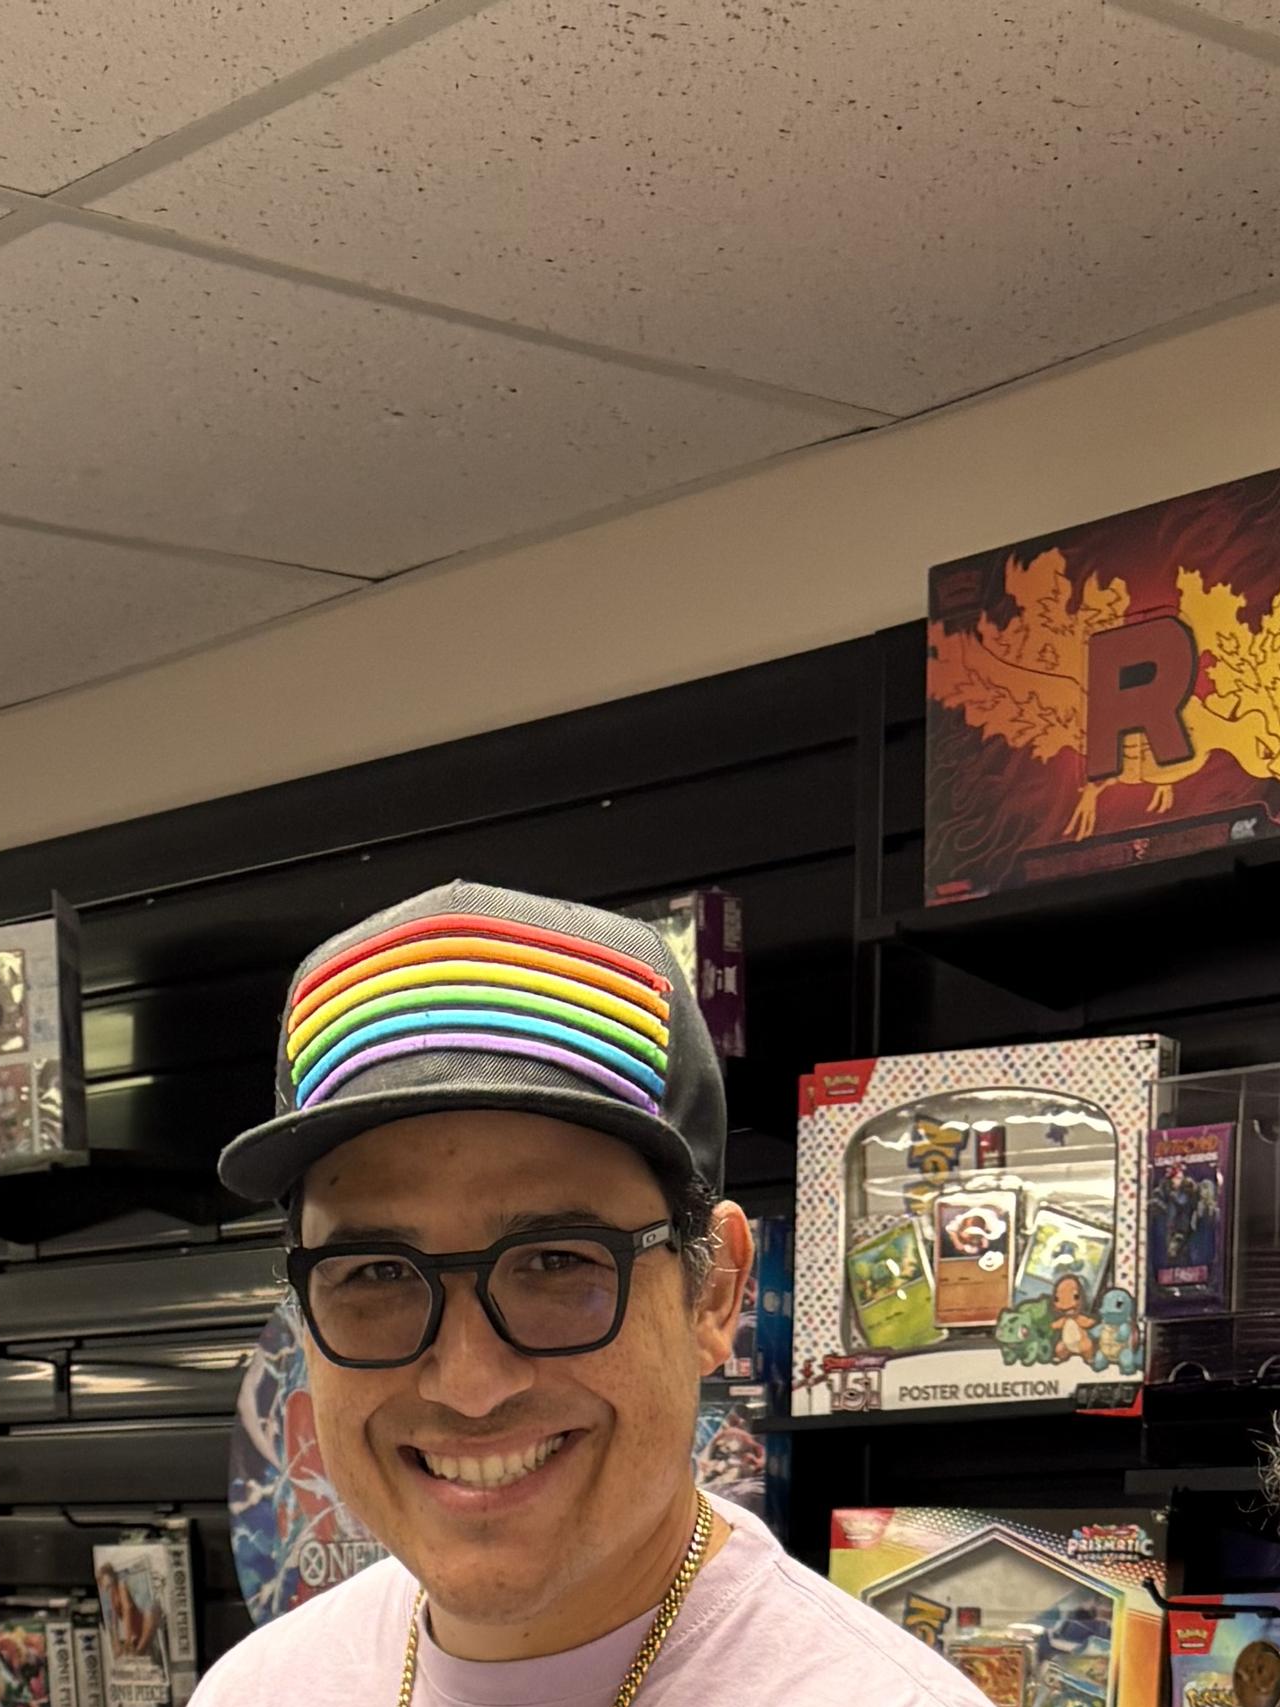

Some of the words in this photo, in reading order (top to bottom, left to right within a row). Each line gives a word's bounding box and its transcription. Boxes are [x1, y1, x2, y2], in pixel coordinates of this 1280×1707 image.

[1087, 615, 1196, 781] R
[827, 1369, 882, 1413] 151
[898, 1384, 960, 1402] POSTER
[964, 1380, 1059, 1398] COLLECTION
[1067, 1536, 1153, 1556] PRISMATIC
